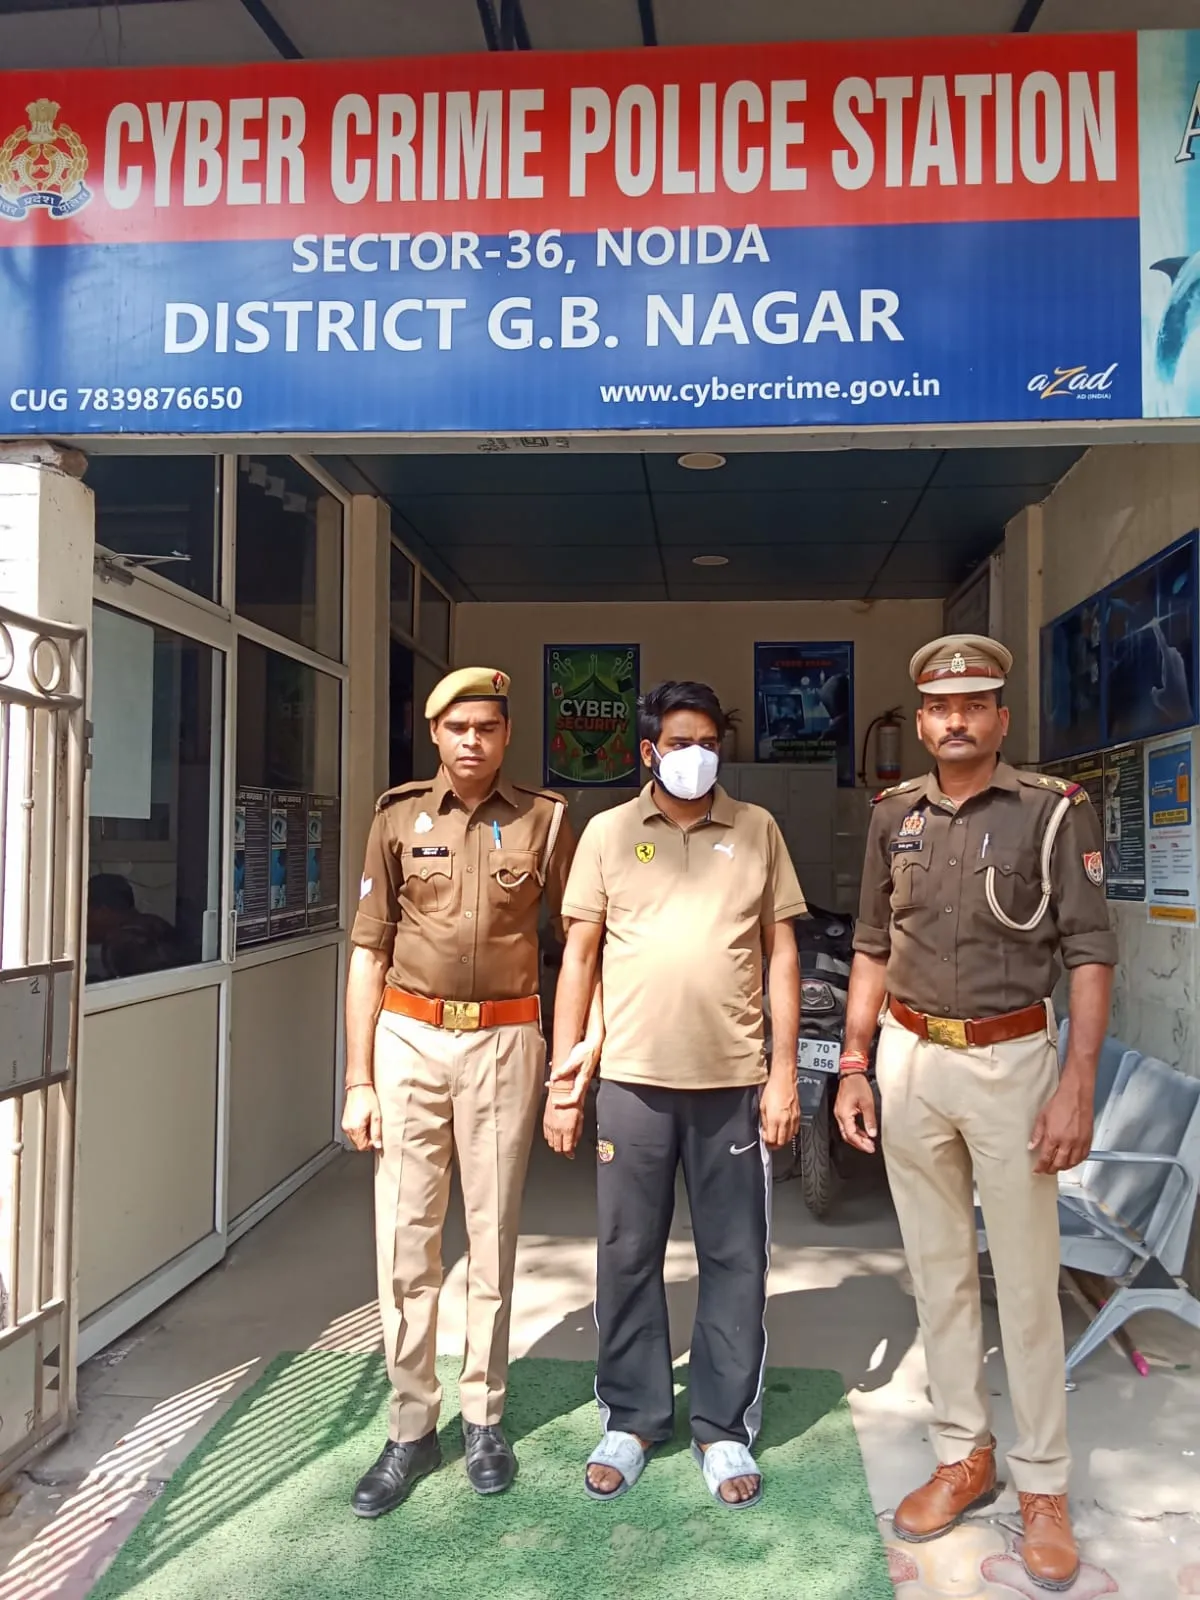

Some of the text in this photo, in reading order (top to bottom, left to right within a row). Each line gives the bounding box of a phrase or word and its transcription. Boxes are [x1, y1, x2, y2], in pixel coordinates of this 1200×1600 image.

[104, 71, 1117, 209] CYBER CRIME POLICE STATION
[292, 224, 770, 274] SECTOR-36, NOIDA
[164, 289, 904, 354] DISTRICT G.B. NAGAR
[10, 386, 243, 412] CUG 7839876650
[600, 372, 941, 408] www.cybercrime.gov.in
[560, 699, 625, 718] CYBER
[556, 718, 628, 732] SECURITY
[798, 1041, 830, 1054] P 70
[813, 1058, 834, 1069] 856
